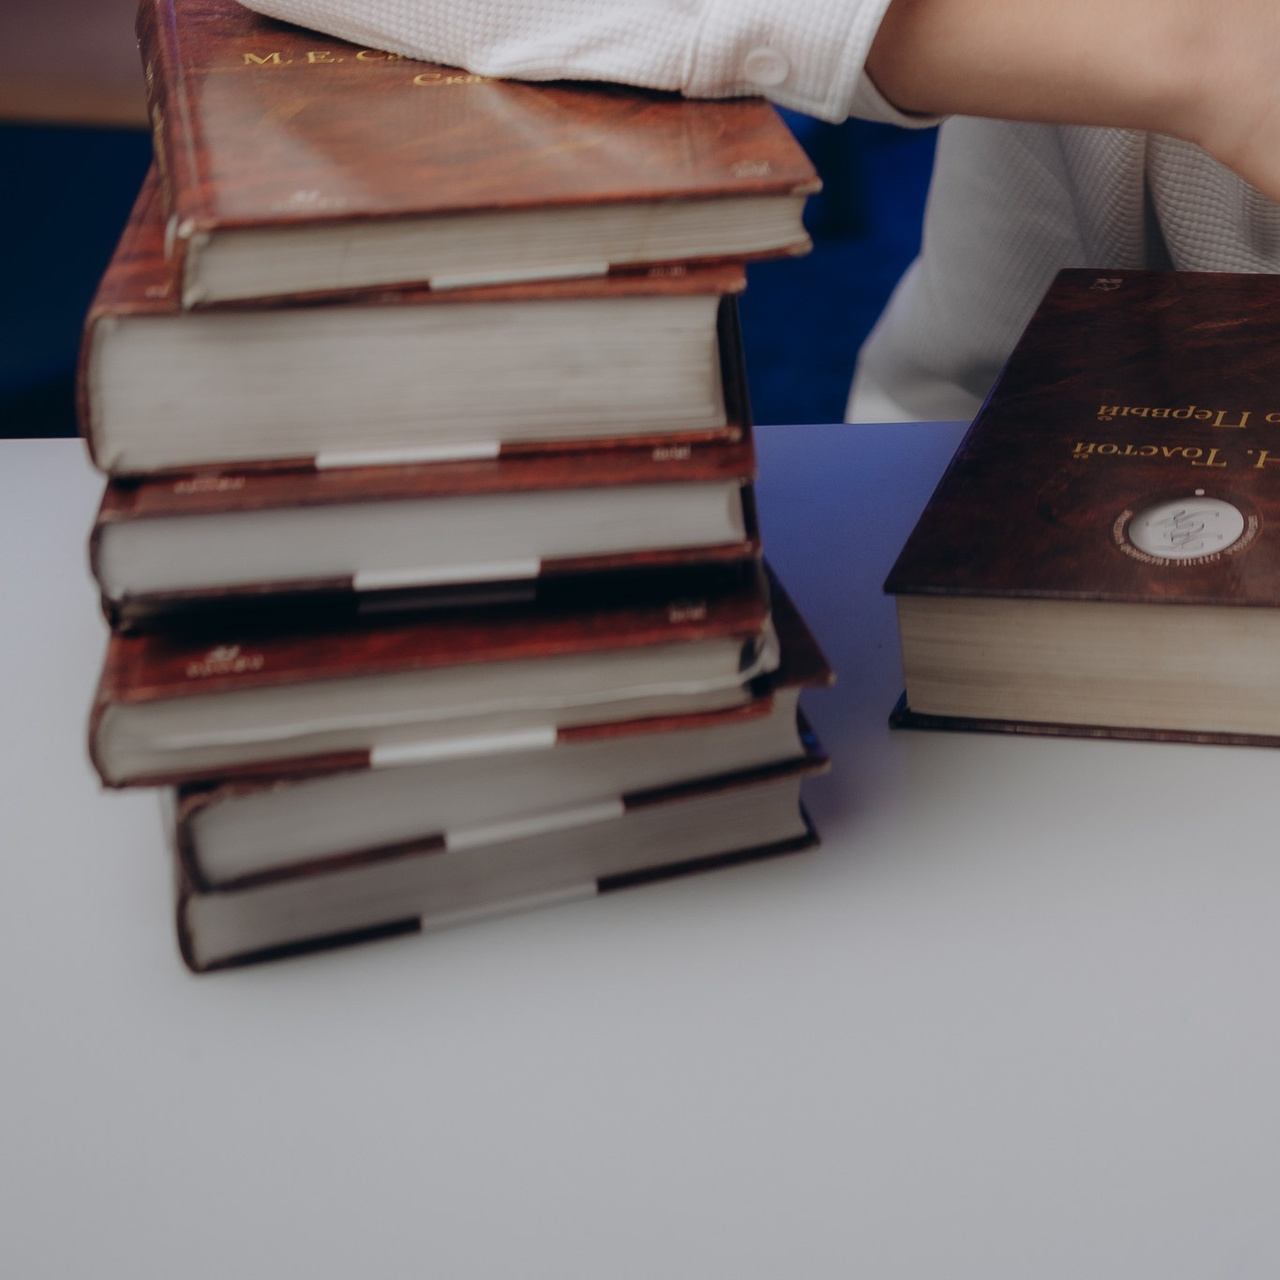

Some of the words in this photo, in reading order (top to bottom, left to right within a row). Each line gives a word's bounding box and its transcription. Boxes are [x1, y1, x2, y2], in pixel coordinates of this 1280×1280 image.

[242, 51, 293, 65] М.
[305, 50, 344, 64] Е.
[412, 72, 497, 87] Ска
[1097, 405, 1252, 429] Первый
[1073, 442, 1228, 468] Толстой
